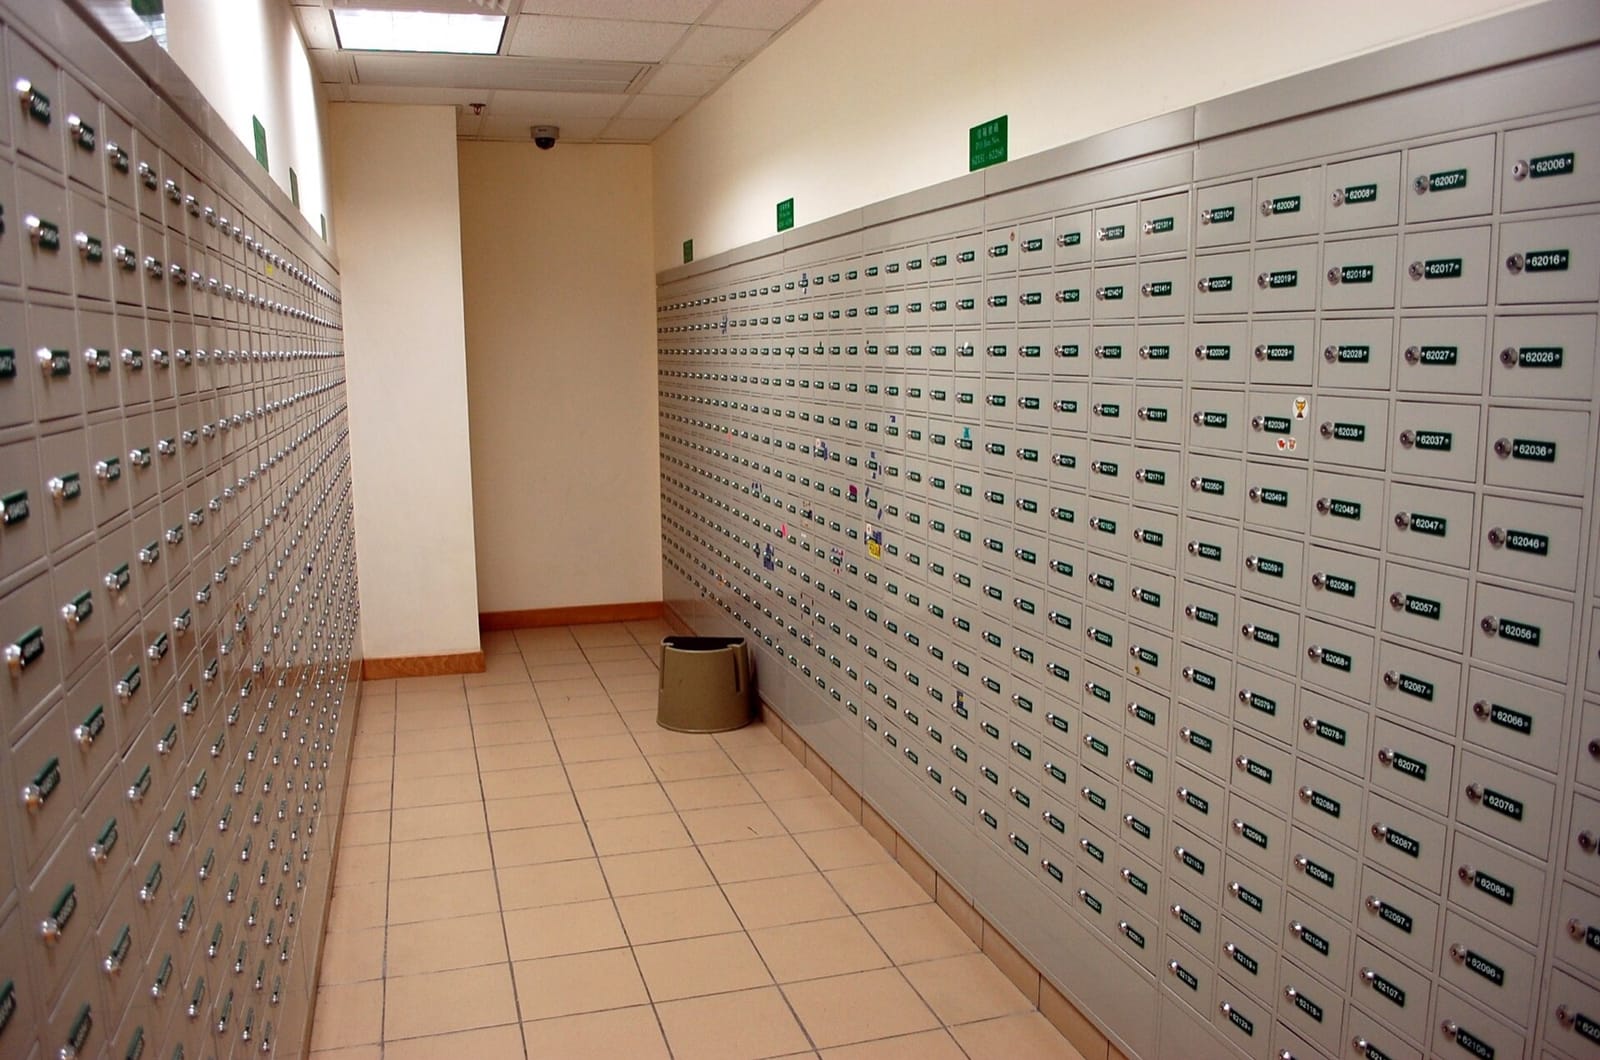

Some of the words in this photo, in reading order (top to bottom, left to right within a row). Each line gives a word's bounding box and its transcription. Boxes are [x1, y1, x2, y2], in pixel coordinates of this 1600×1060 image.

[1536, 156, 1566, 173] 62006
[1435, 173, 1460, 187] 62007
[1349, 186, 1371, 200] 62008
[1430, 261, 1455, 274] 62017
[1531, 253, 1561, 267] 62016
[1346, 268, 1367, 279] 62018
[1343, 348, 1363, 359] 62028
[1426, 349, 1450, 360] 62027
[1525, 350, 1554, 362] 62026
[1338, 425, 1359, 437] 62038
[1421, 434, 1444, 446] 62037
[1519, 443, 1547, 457] 62036
[1335, 502, 1355, 515] 62048
[1416, 516, 1439, 531] 62047
[1512, 534, 1540, 550] 62046
[1330, 578, 1350, 592] 62058
[1410, 598, 1434, 614] 62057
[1505, 623, 1532, 640] 62056
[1326, 651, 1345, 667] 62068
[1404, 678, 1427, 695] 62067
[1497, 709, 1524, 728] 62066
[1321, 724, 1340, 741] 62078
[1398, 756, 1420, 775] 62077
[1316, 794, 1335, 812] 62088
[1489, 793, 1515, 814] 62076
[1391, 832, 1413, 852] 62087
[1310, 864, 1329, 883] 62098
[1480, 876, 1506, 898] 62086
[1384, 906, 1406, 927] 62097
[1305, 931, 1324, 951] 62108
[1471, 955, 1496, 979] 62096
[1378, 978, 1399, 1001] 62107
[1299, 996, 1318, 1017] 62118
[1582, 1021, 1600, 1040] 620
[1462, 1035, 1486, 1057] 62106
